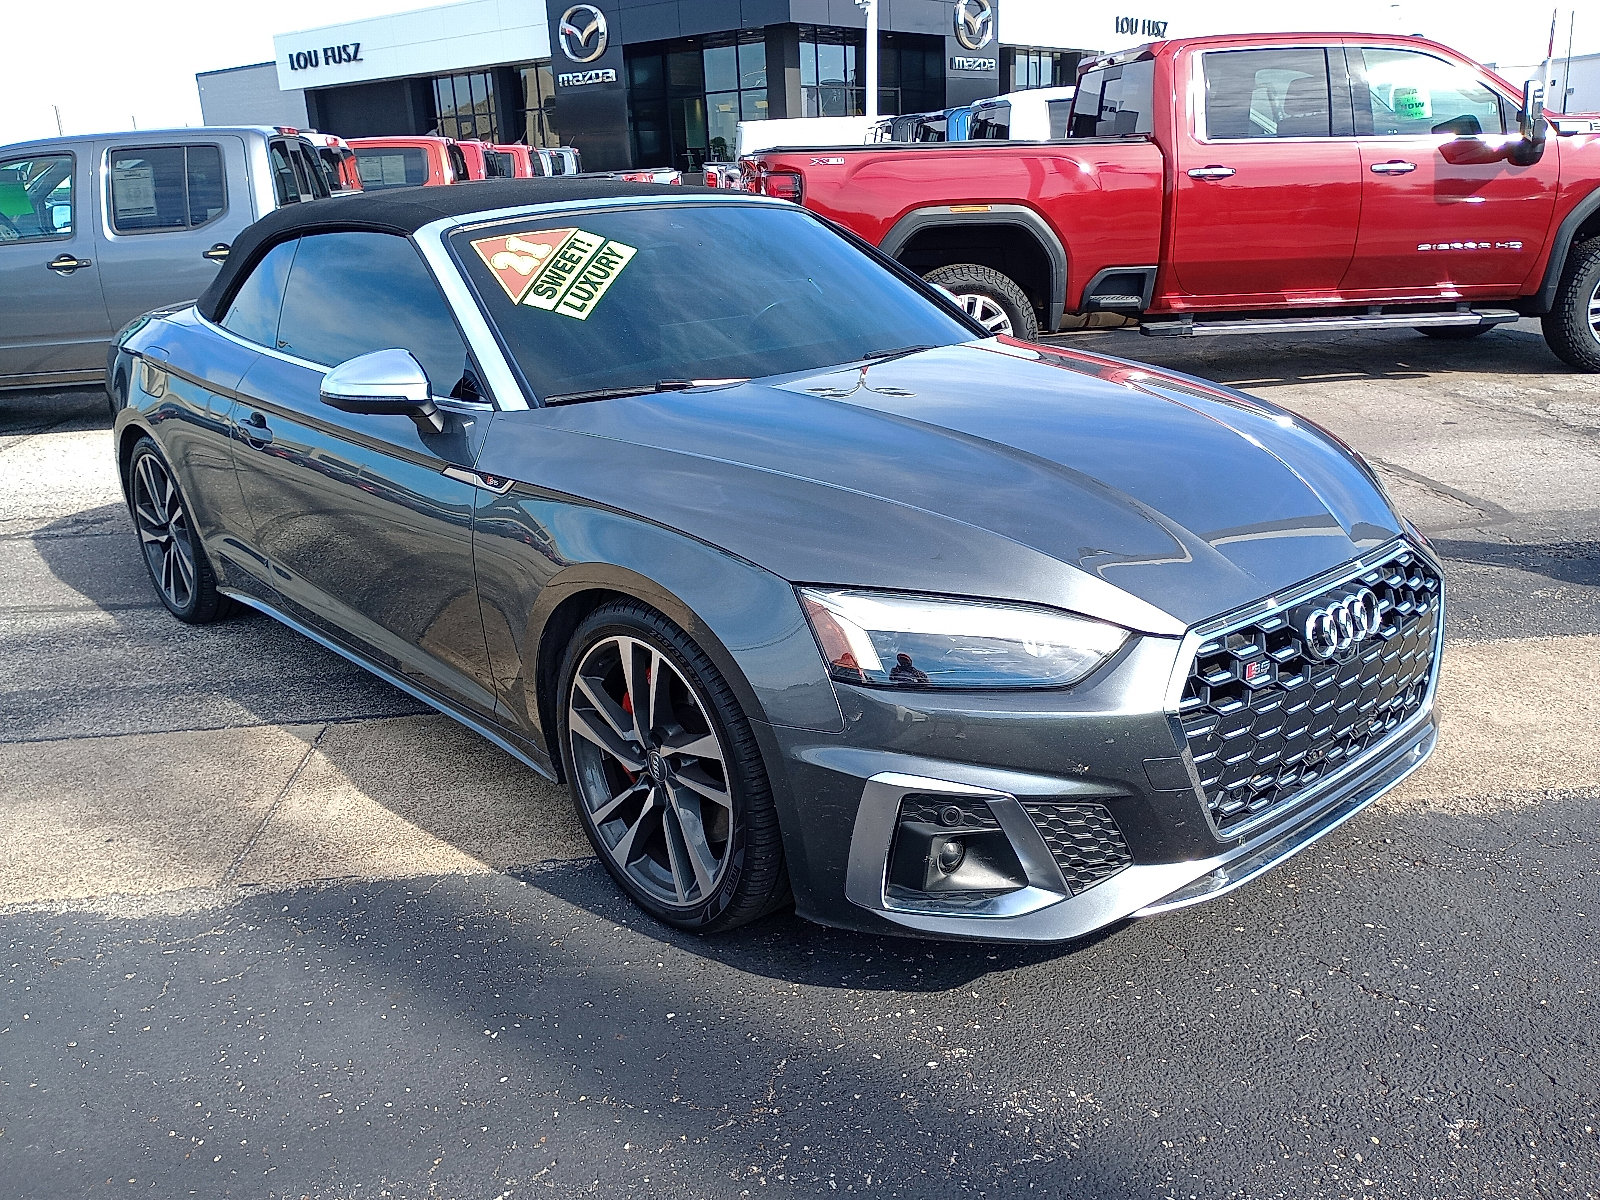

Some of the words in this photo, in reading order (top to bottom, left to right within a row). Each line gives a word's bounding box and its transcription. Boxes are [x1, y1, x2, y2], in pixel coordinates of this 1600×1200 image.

[288, 49, 319, 71] LOU
[322, 42, 363, 66] FUSZ
[558, 68, 617, 87] mazda
[490, 236, 553, 276] 21
[533, 237, 593, 300] SWEET!
[563, 246, 624, 313] LUXURY
